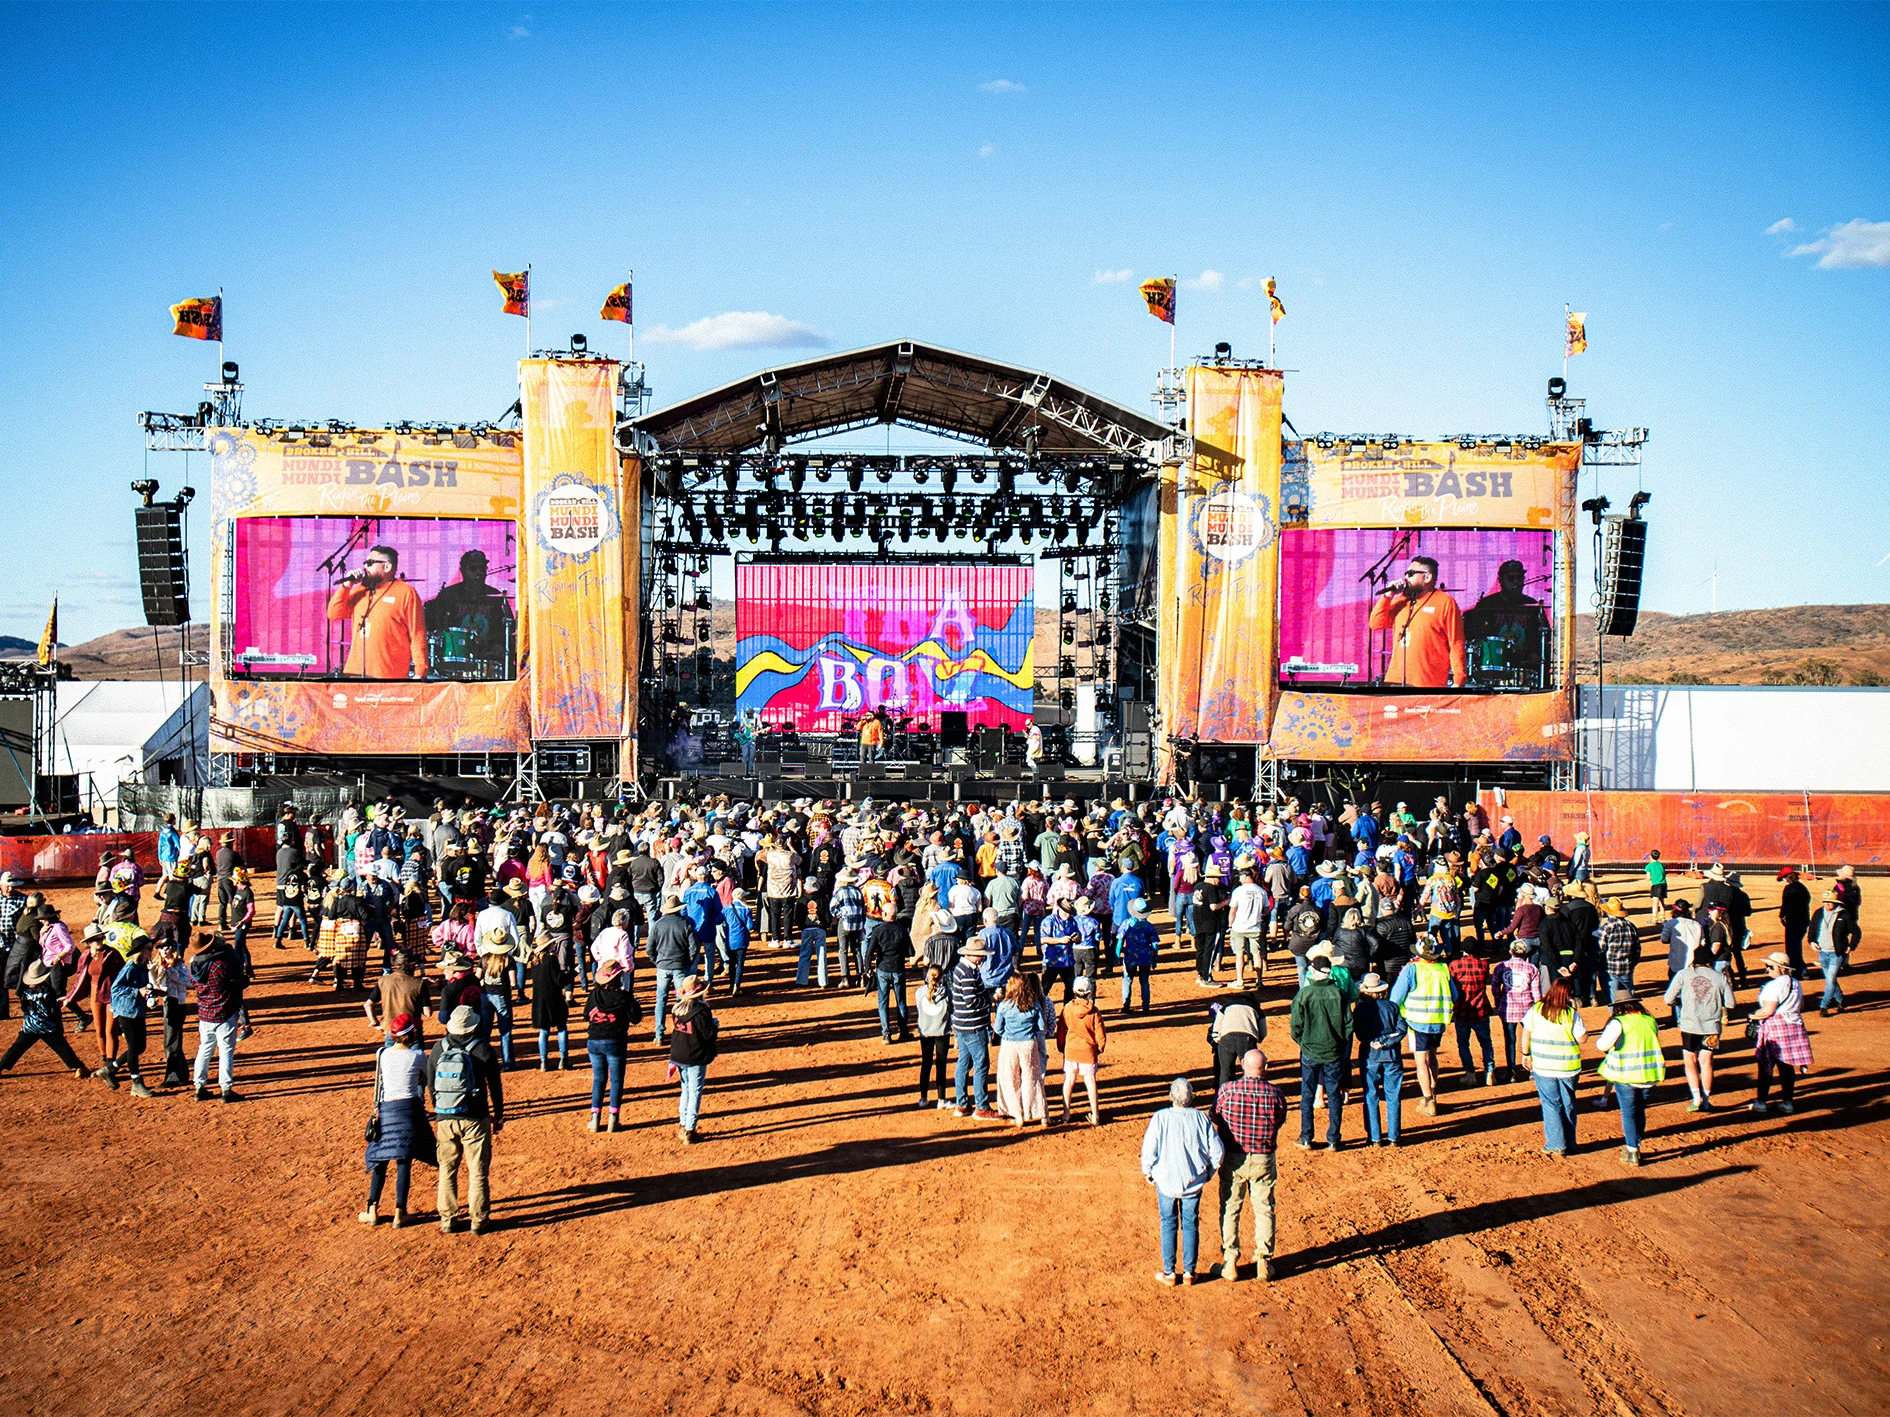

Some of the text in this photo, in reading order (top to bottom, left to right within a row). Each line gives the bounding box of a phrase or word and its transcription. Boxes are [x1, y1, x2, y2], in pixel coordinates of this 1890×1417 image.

[282, 460, 341, 472] MUNDI
[345, 454, 459, 488] BASH
[281, 473, 341, 485] MUNDI
[1341, 473, 1400, 485] MUNDI
[1404, 466, 1513, 498] BASH
[1341, 486, 1400, 499] MUNDI
[550, 506, 598, 516] MUNDI
[550, 516, 598, 526] MUNDI
[551, 523, 598, 539] BASH
